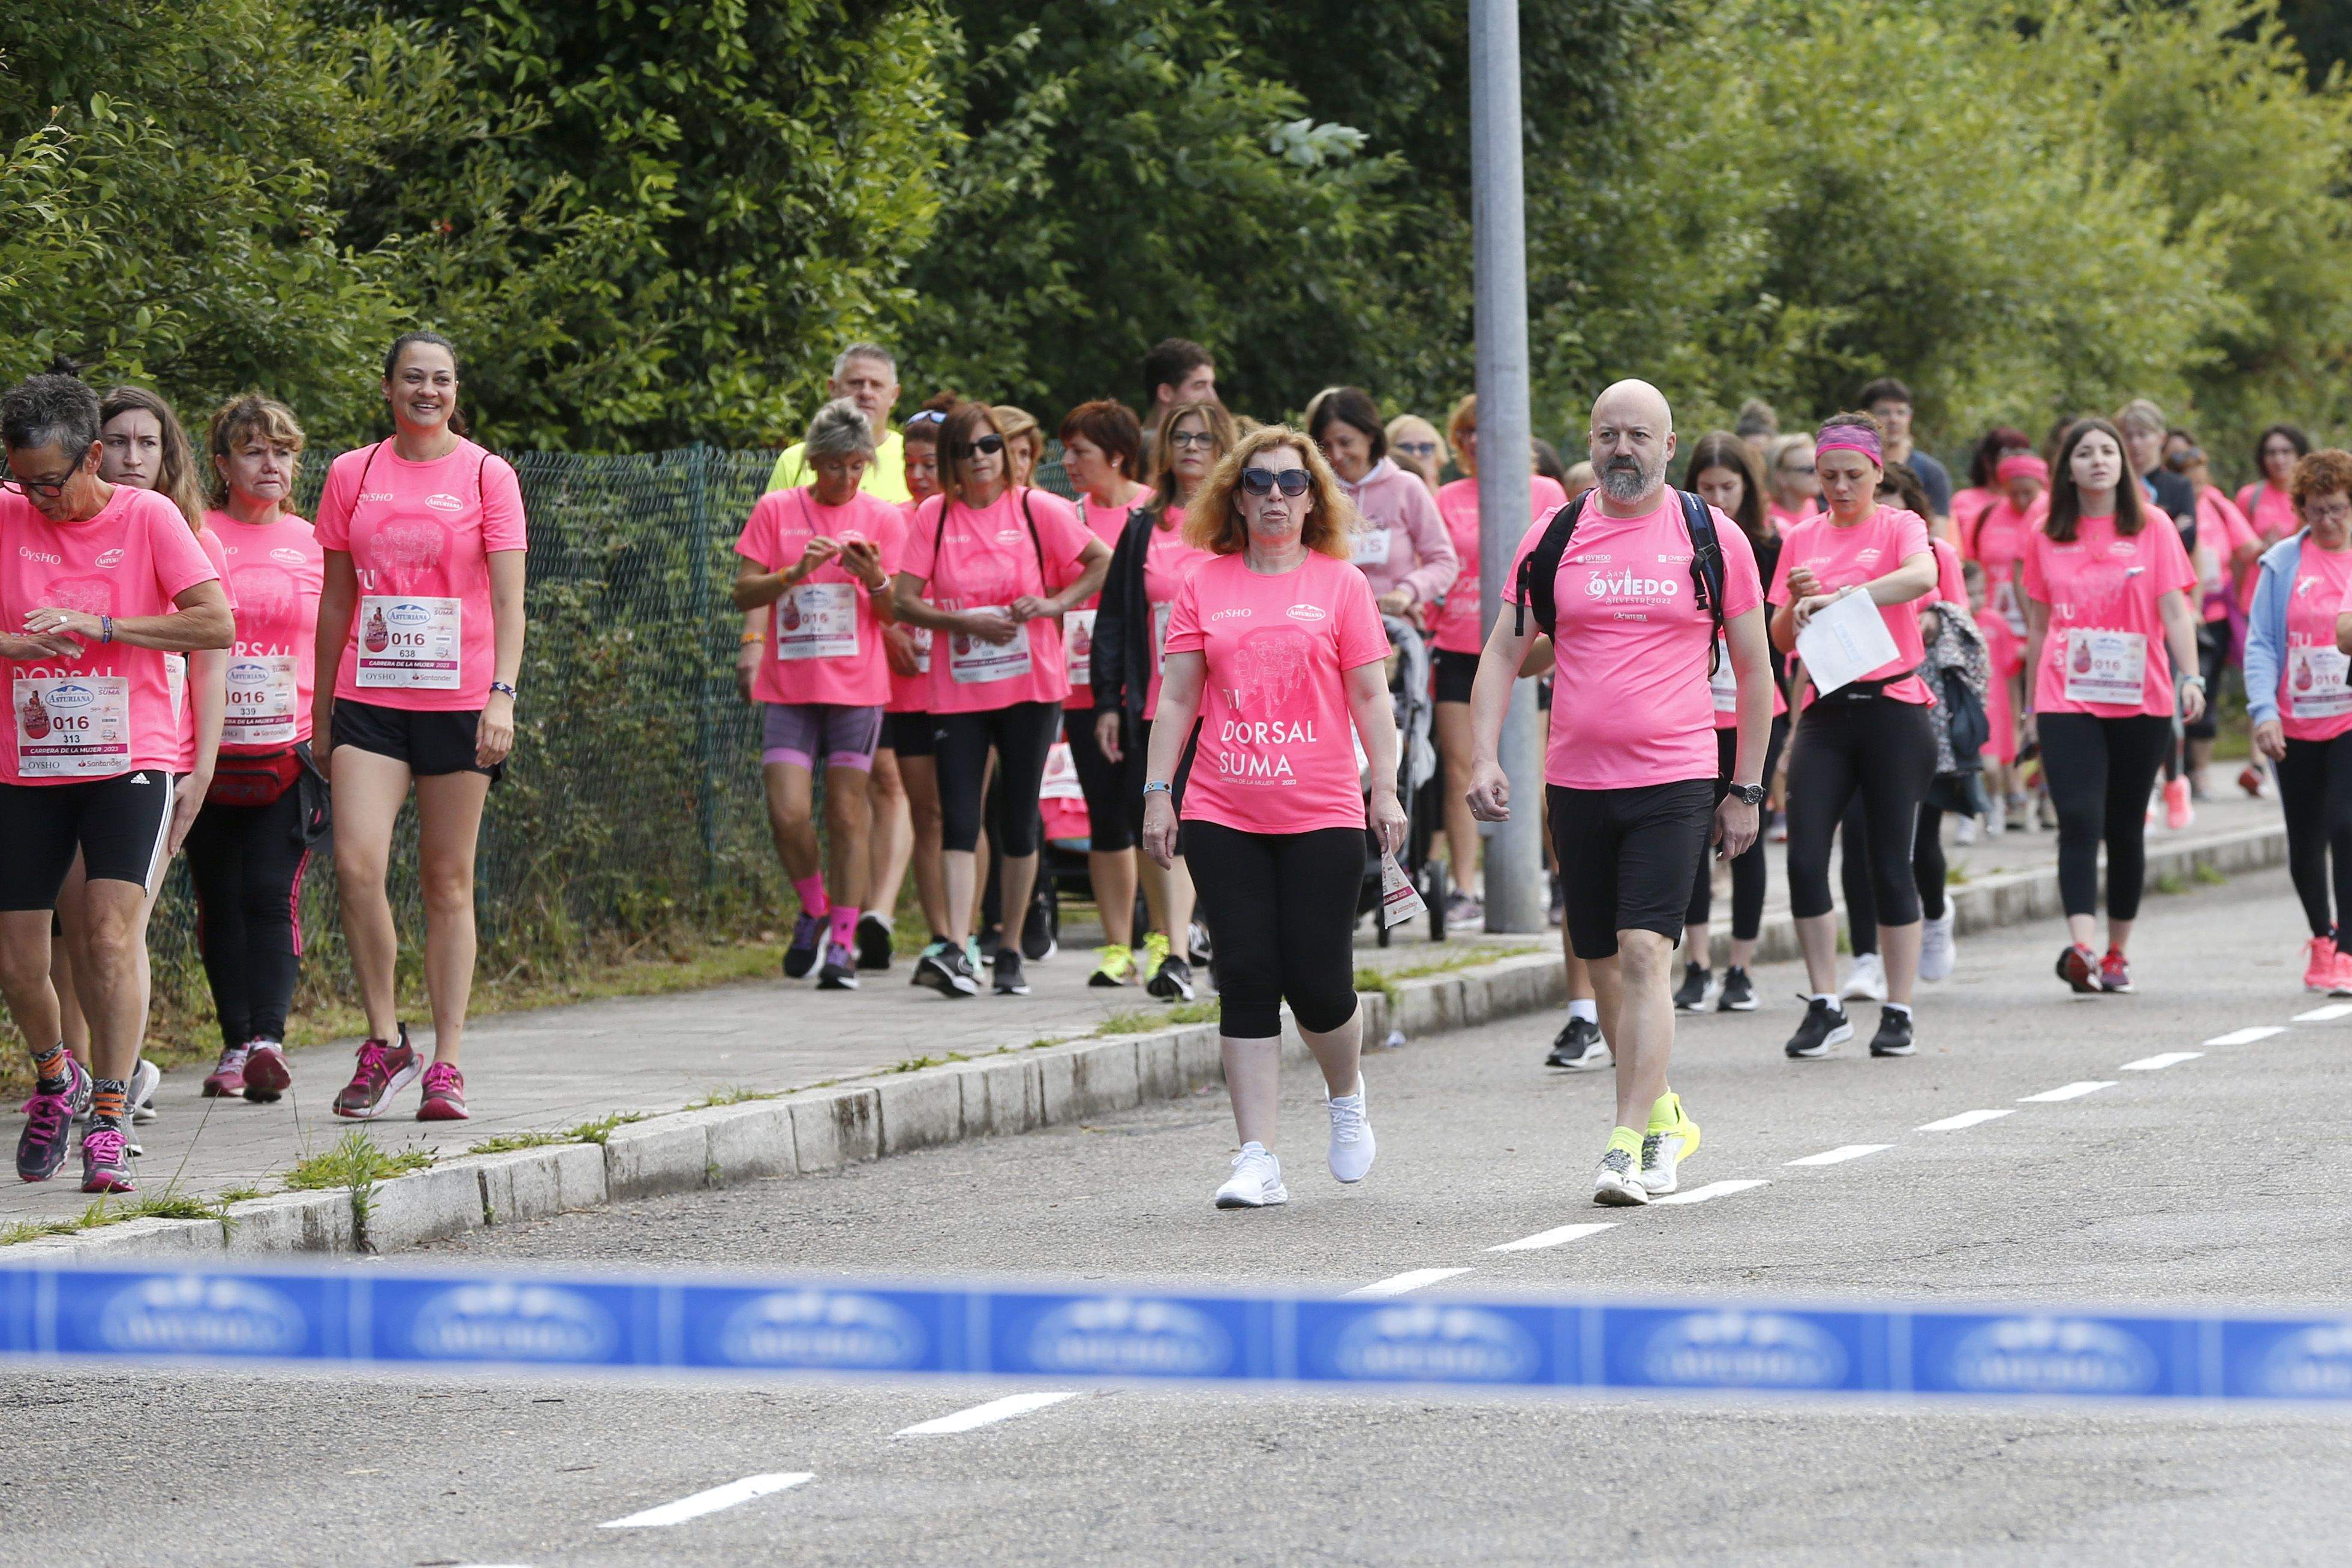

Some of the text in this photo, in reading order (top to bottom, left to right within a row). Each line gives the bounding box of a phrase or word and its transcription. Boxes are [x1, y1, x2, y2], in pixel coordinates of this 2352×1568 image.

[359, 493, 393, 502] OYSHO
[428, 499, 459, 508] ASTURIANA
[19, 546, 61, 565] OYSHO
[1607, 569, 1625, 579] SAN
[1606, 595, 1653, 606] SILVESTRE
[390, 612, 428, 621] ASTURIANA
[802, 613, 829, 624] 016
[1211, 608, 1252, 621] OYSHO
[1291, 609, 1322, 618] ASTURIANA
[392, 633, 425, 645] 016
[230, 672, 266, 681] ASTURIANA
[49, 694, 91, 703] ASTURIANA
[231, 691, 264, 703] 016
[53, 716, 89, 730] 016
[261, 728, 288, 736] Santander
[1220, 720, 1317, 744] DORSAL
[64, 735, 80, 743] 313
[28, 761, 60, 769] OYSHO
[87, 758, 122, 768] Santander
[1219, 751, 1294, 777] SUMA
